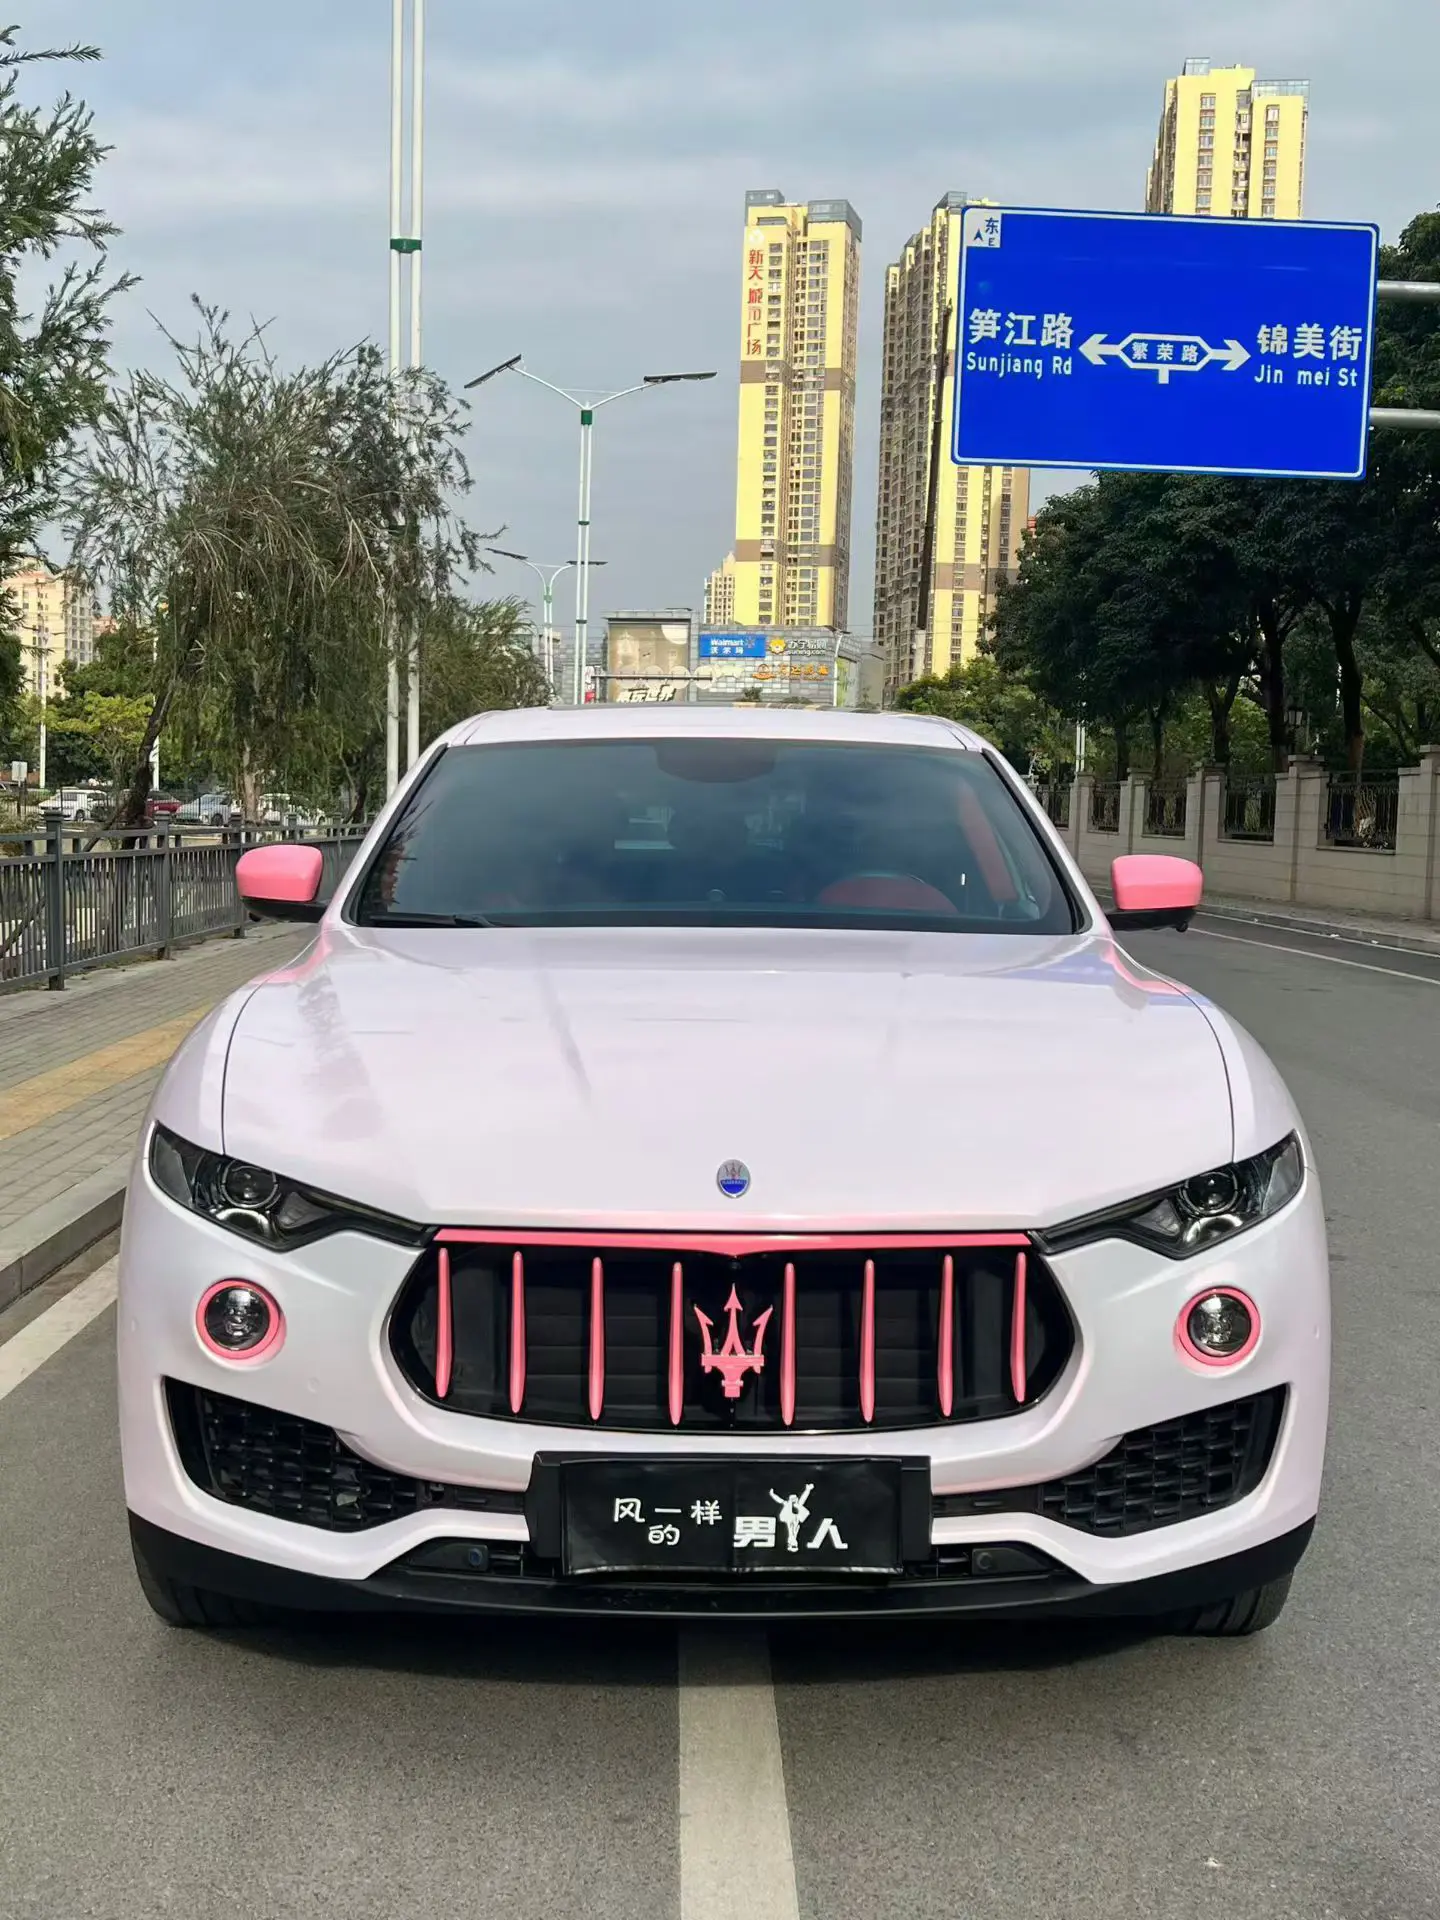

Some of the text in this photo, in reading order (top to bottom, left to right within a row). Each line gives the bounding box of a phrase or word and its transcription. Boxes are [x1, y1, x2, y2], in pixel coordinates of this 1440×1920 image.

[984, 218, 999, 235] 东
[987, 237, 995, 247] E
[968, 308, 1074, 350] 笋江路
[1131, 341, 1199, 364] 繁荣路
[1256, 323, 1362, 361] 锦美街
[966, 351, 1073, 380] Sunjiang Rd
[1254, 364, 1358, 387] Jin mei St
[710, 646, 744, 654] 沃尔玛
[613, 1497, 723, 1526] 风一样
[648, 1524, 680, 1546] 的
[733, 1515, 849, 1550] 男人
